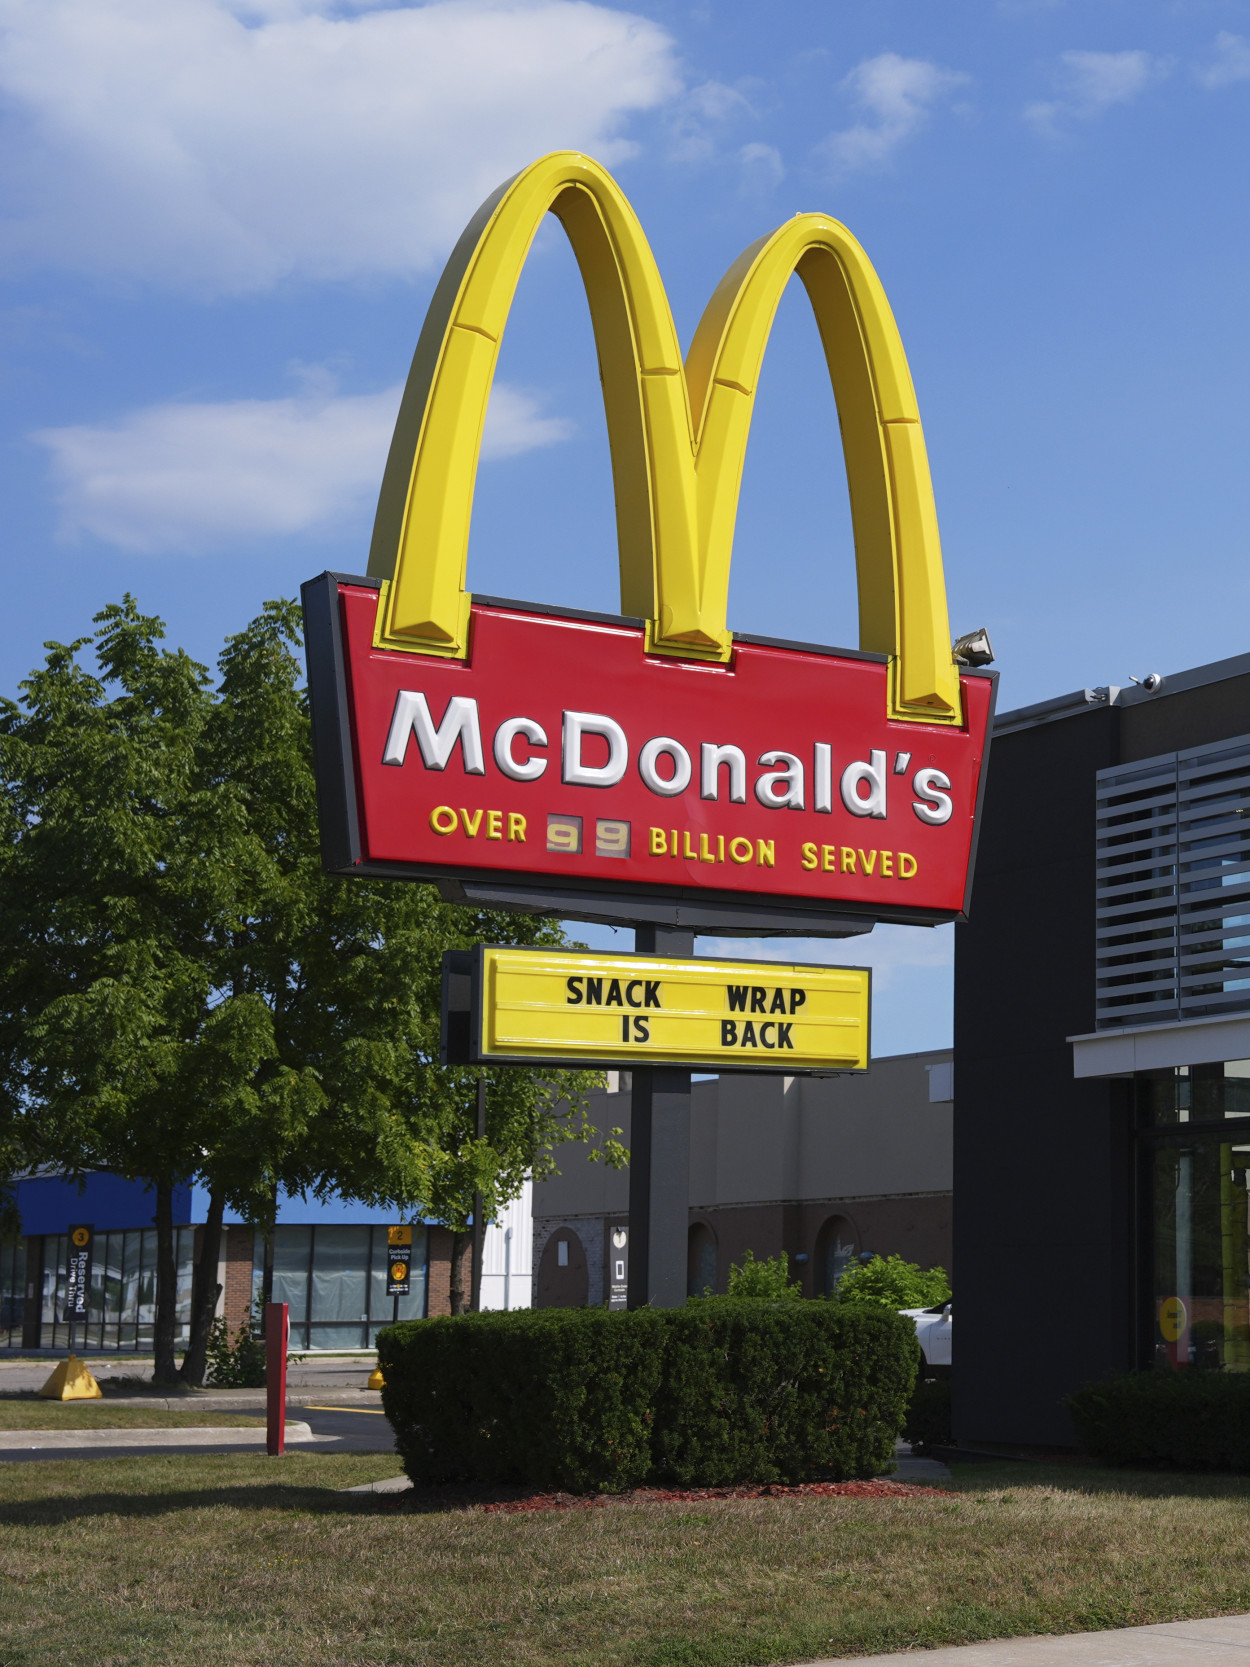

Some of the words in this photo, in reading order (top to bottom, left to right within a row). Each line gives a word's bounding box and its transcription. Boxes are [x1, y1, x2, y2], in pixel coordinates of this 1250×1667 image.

[381, 688, 953, 826] McDonald's
[429, 805, 528, 843] OVER
[648, 826, 776, 868] BILLION
[801, 842, 918, 880] SERVED
[566, 976, 661, 1008] SNACK
[726, 984, 807, 1015] WRAP
[622, 1014, 650, 1043] IS
[721, 1019, 794, 1049] BACK
[78, 1232, 84, 1241] 3
[397, 1230, 404, 1241] 2
[69, 1258, 79, 1283] Drive
[75, 1251, 89, 1313] Reserved
[67, 1285, 77, 1307] Thru
